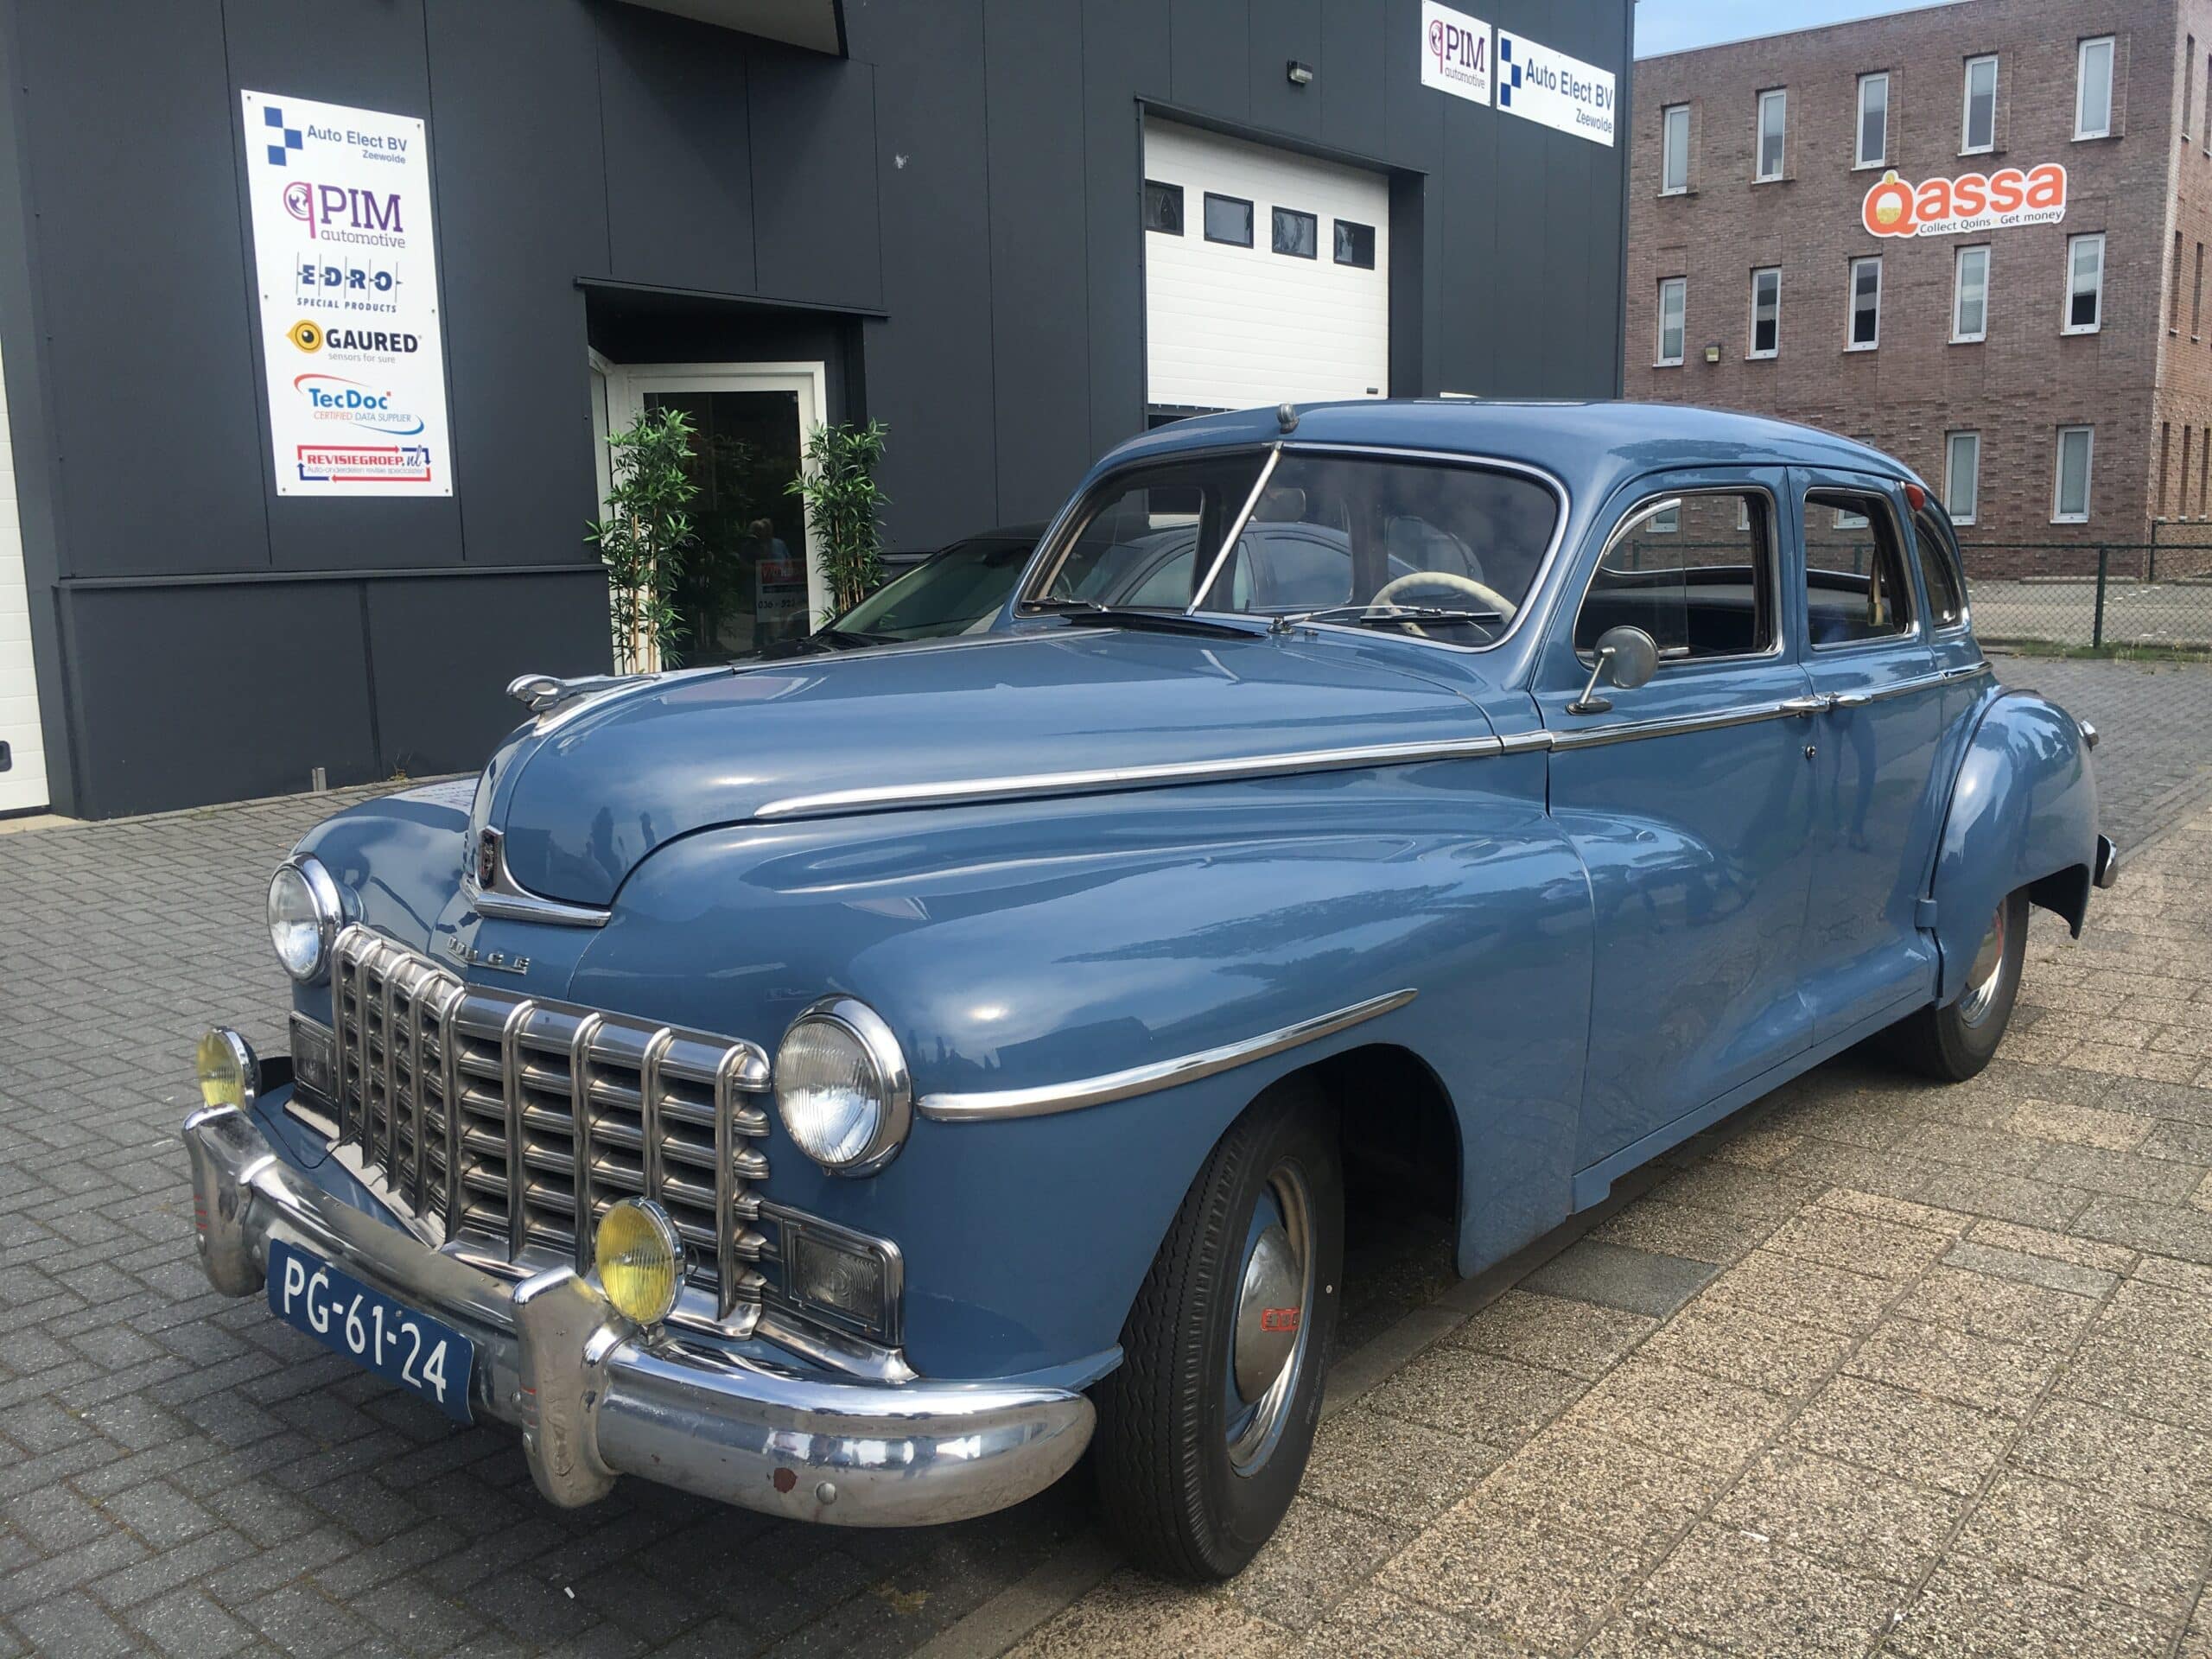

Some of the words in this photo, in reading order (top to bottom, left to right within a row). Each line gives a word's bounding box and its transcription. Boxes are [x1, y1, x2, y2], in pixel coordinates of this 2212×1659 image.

[1446, 24, 1485, 73] PIM
[1445, 66, 1485, 89] automotive
[1526, 58, 1556, 90] Auto
[1560, 71, 1592, 104] Elect
[1596, 85, 1613, 111] BV
[1576, 108, 1612, 133] Zeewolde
[307, 124, 342, 142] Auto
[346, 130, 383, 149] Elect
[387, 137, 407, 151] BV
[362, 149, 406, 164] Zeewolde
[318, 184, 404, 232] PIM
[1865, 166, 2063, 236] Qassa
[1920, 222, 1957, 234] Collect
[1961, 219, 1991, 231] Qoins
[2000, 214, 2019, 225] Get
[2024, 211, 2063, 223] money
[321, 230, 406, 249] automotive
[302, 264, 392, 291] EDRO
[296, 297, 340, 308] SPECIAL
[345, 302, 397, 313] PRODUCTS
[326, 328, 418, 353] GAURED
[328, 353, 361, 362] sensors
[363, 353, 376, 362] for
[308, 388, 388, 410] TecDoc
[314, 411, 353, 421] CERTIFIED
[354, 412, 376, 422] DATA
[378, 413, 411, 423] SUPPLIER
[283, 1256, 447, 1403] PG-61-24
